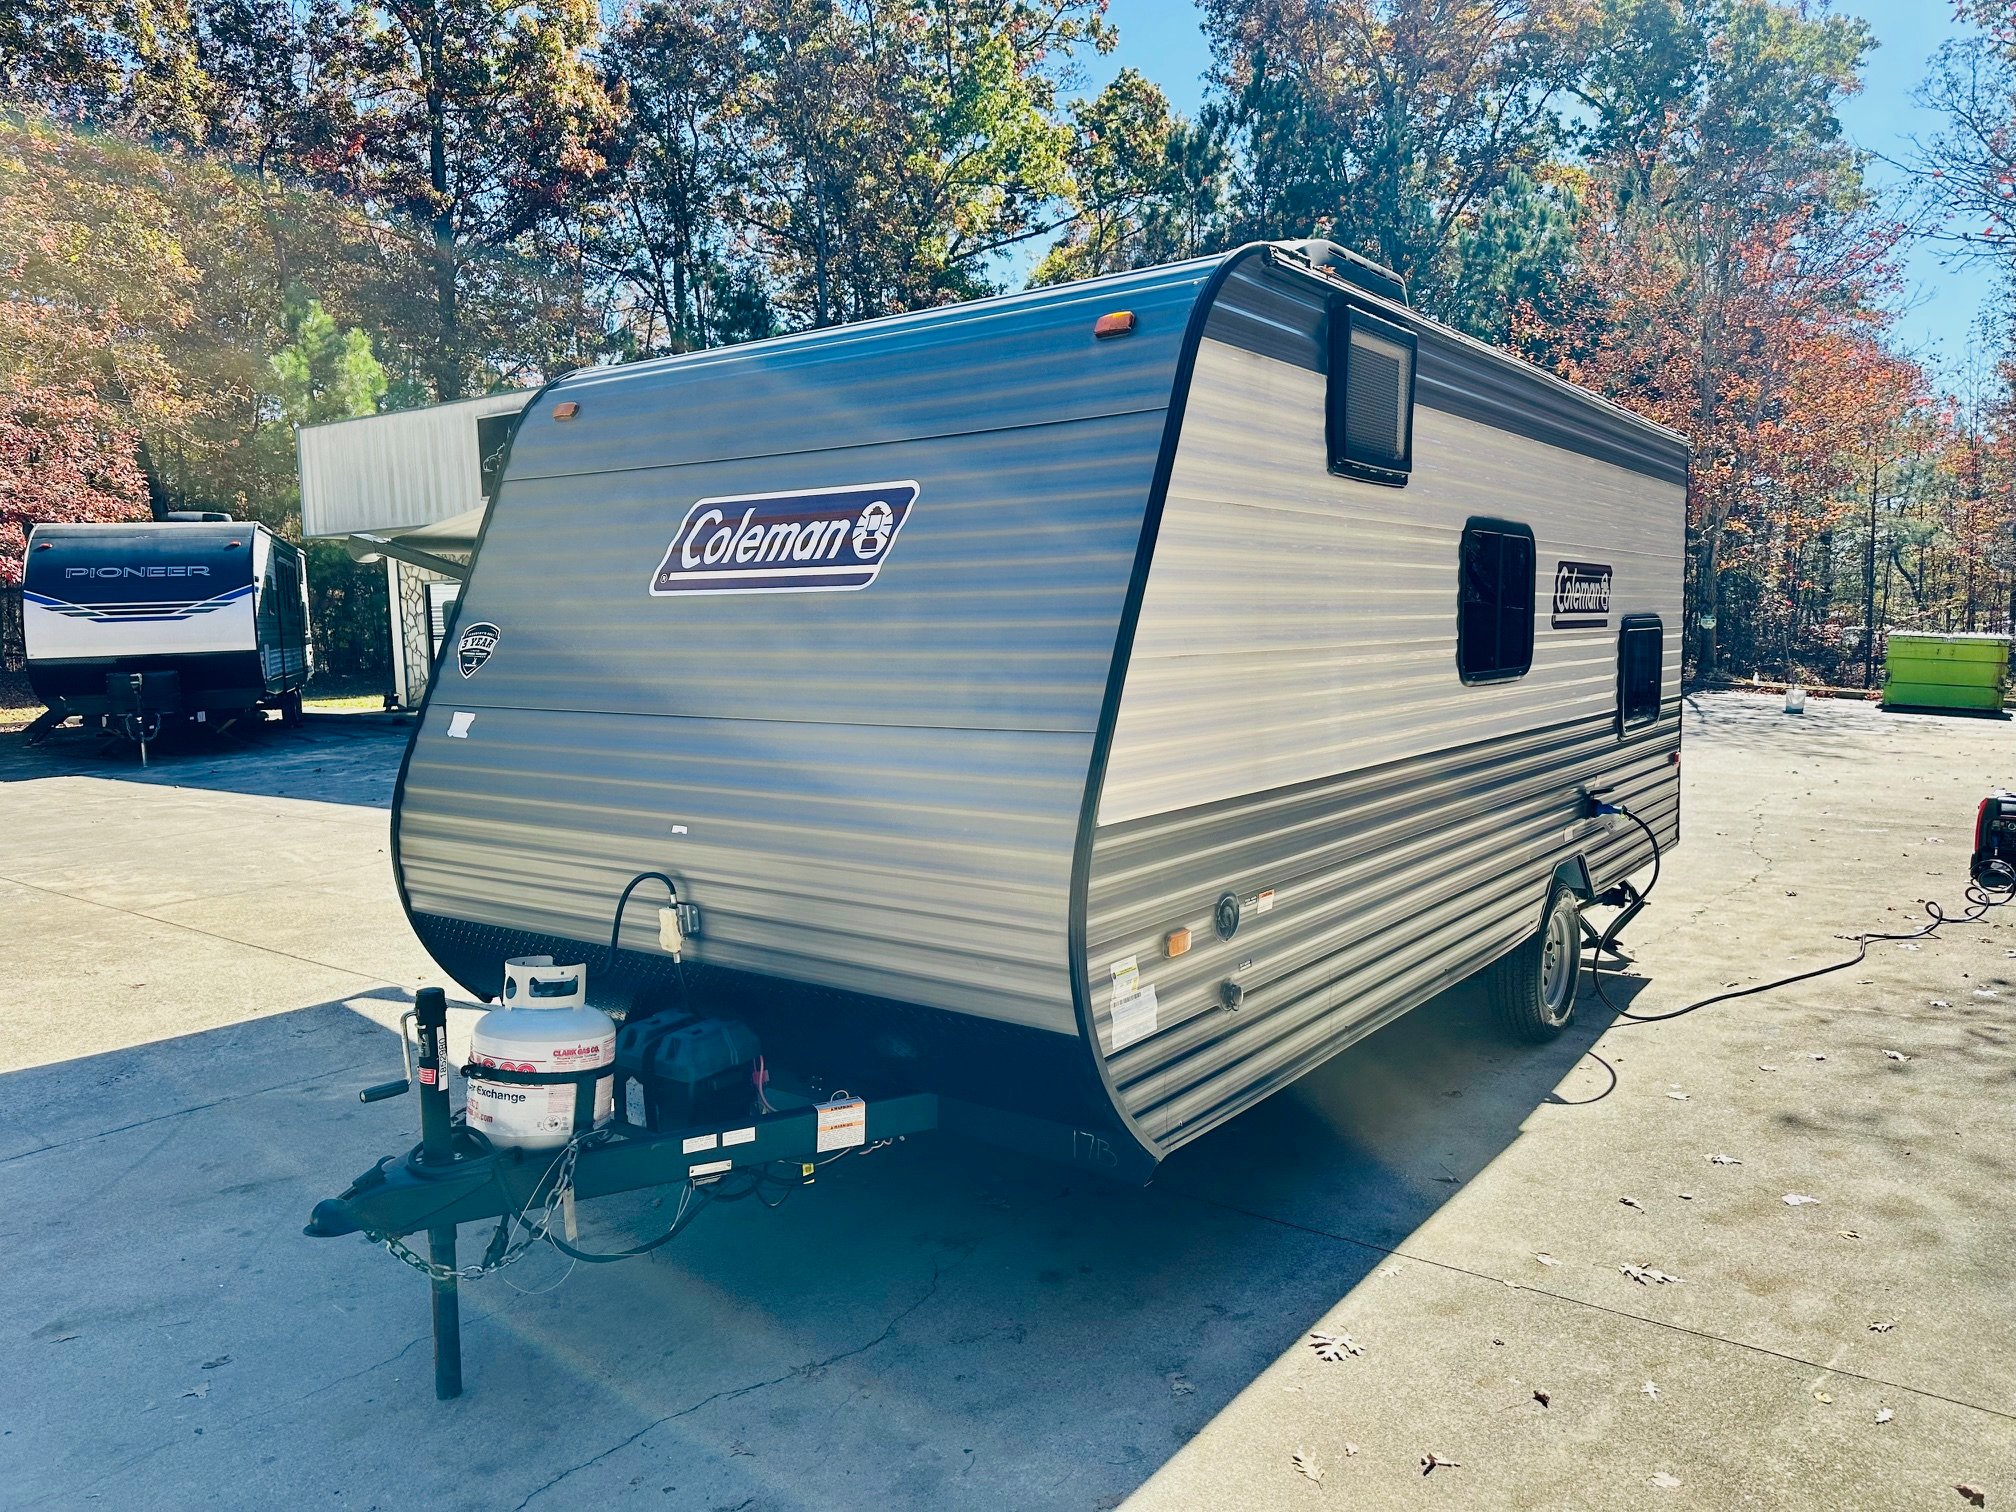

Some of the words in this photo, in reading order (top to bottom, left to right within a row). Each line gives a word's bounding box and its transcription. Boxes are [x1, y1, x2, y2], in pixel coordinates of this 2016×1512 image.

[681, 507, 851, 569] Coleman
[65, 566, 211, 579] PIONEER
[1556, 566, 1601, 613] Coleman
[462, 639, 468, 649] 3
[470, 637, 494, 649] YEAR
[553, 1048, 577, 1057] CLARK
[577, 1047, 590, 1055] GAS
[477, 1085, 526, 1104] Exchange
